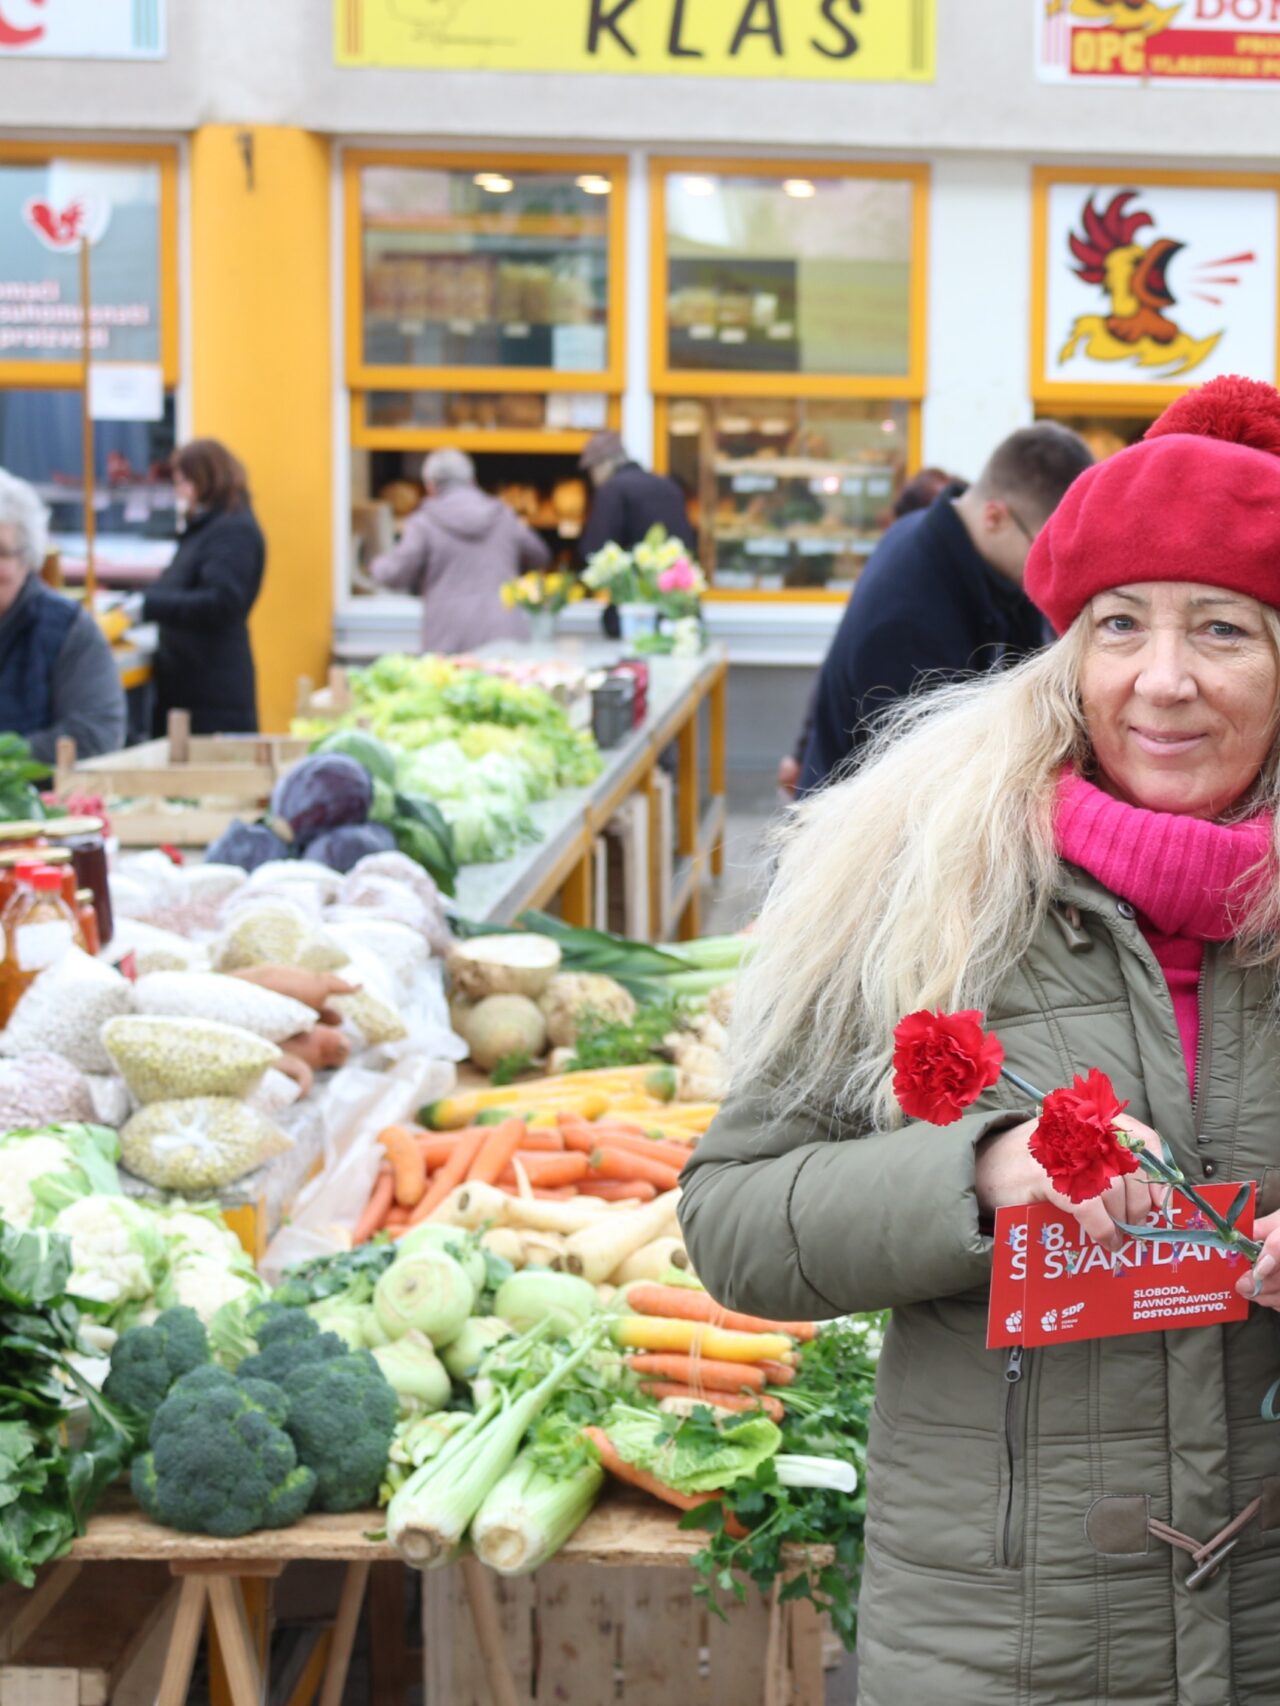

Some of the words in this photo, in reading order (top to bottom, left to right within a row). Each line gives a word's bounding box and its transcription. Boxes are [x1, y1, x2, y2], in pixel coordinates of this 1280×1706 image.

[585, 0, 864, 60] KLAS
[1073, 31, 1146, 72] OPG
[1043, 1240, 1145, 1279] SVAKI
[1133, 1286, 1189, 1299] SLOBODA.
[1133, 1291, 1232, 1309] RAVNOPRAVNOST.
[1061, 1302, 1085, 1319] SDP
[1132, 1302, 1227, 1320] DOSTOJANSTVO.
